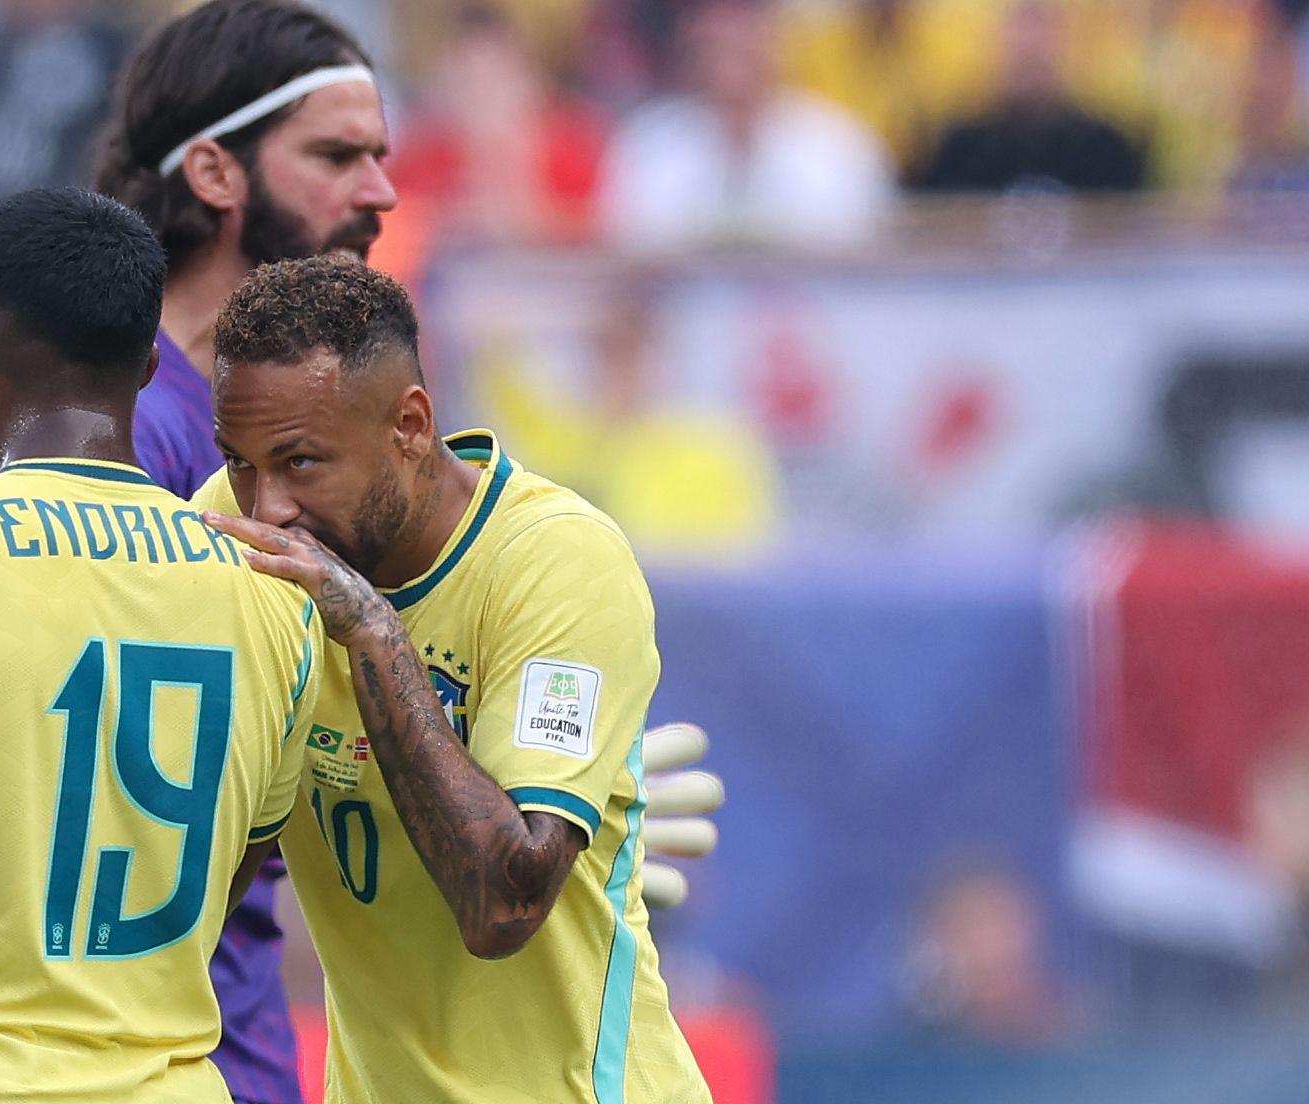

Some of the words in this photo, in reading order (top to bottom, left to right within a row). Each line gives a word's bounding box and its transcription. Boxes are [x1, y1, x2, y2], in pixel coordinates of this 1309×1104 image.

[530, 717, 582, 738] EDUCATION
[545, 733, 564, 743] FIFA
[44, 636, 237, 962] 19
